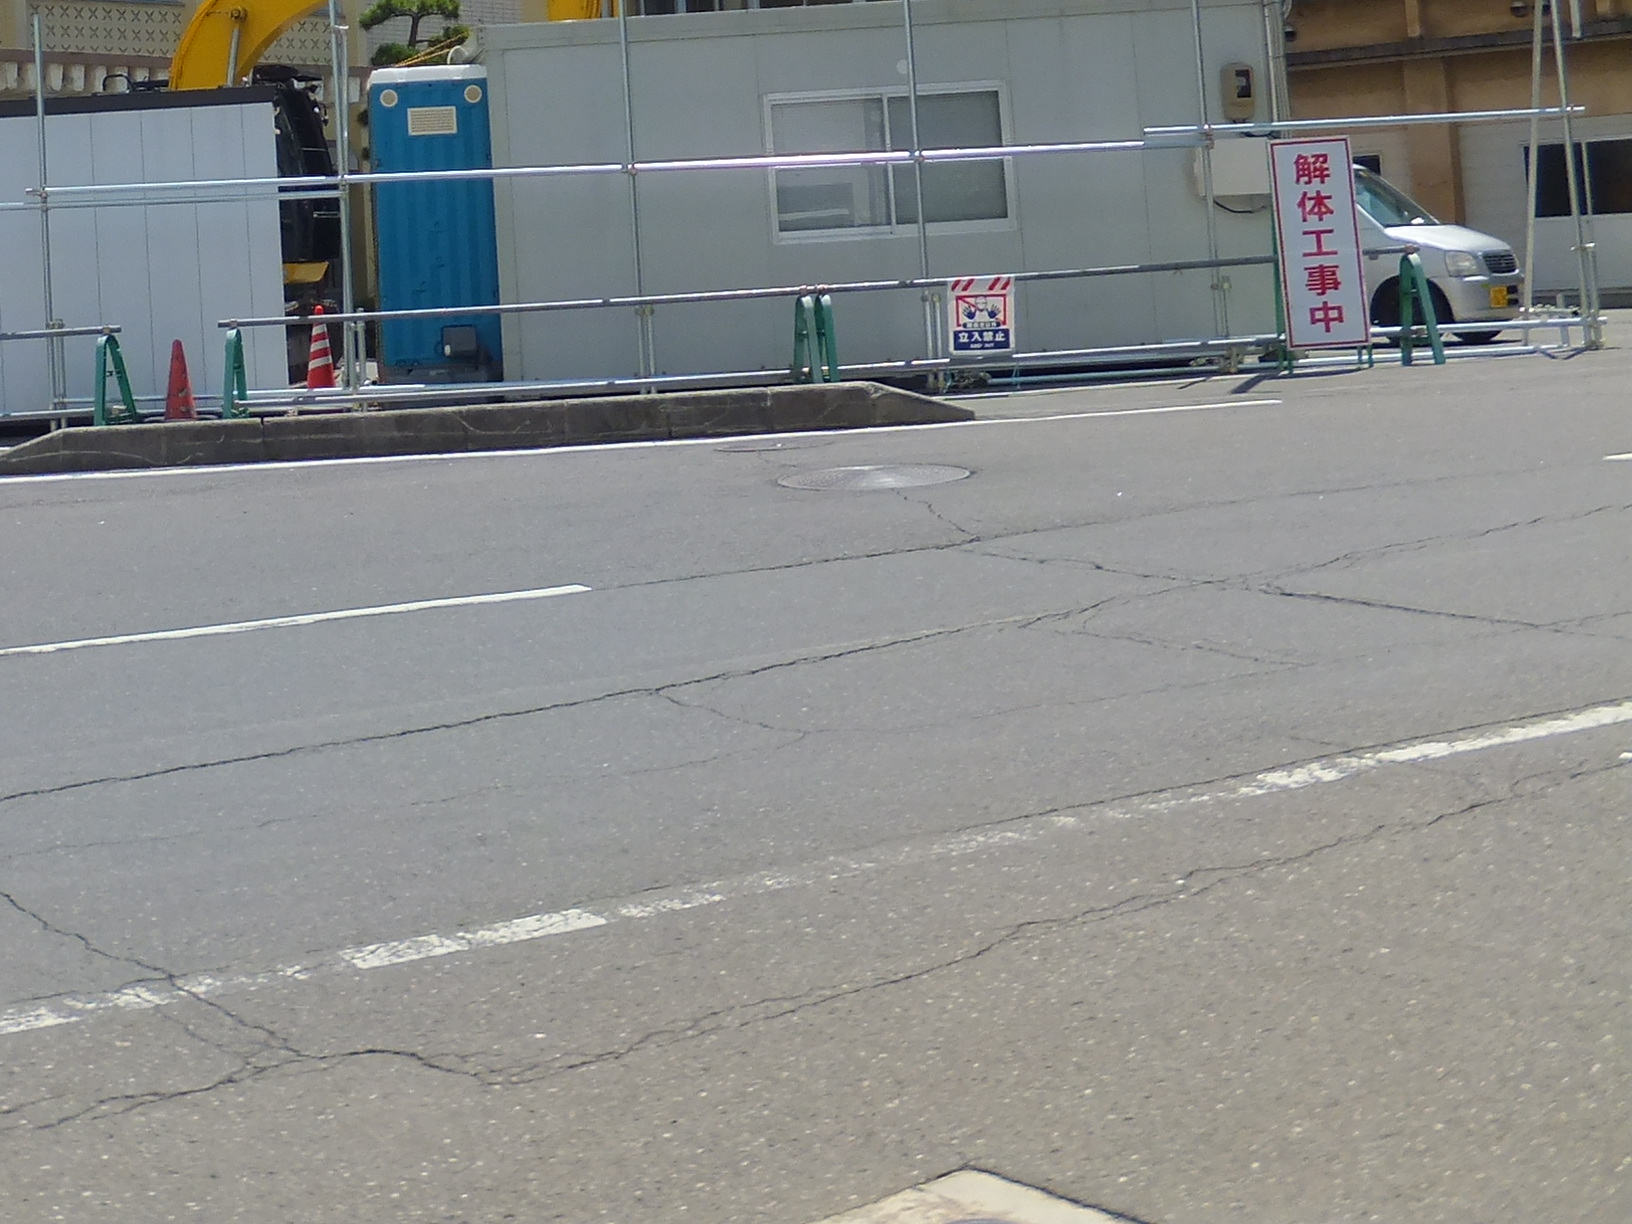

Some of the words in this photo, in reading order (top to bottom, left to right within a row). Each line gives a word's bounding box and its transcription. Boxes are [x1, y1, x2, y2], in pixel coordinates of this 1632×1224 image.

[1293, 153, 1345, 333] 解体工事中
[958, 331, 1006, 343] 立入禁止
